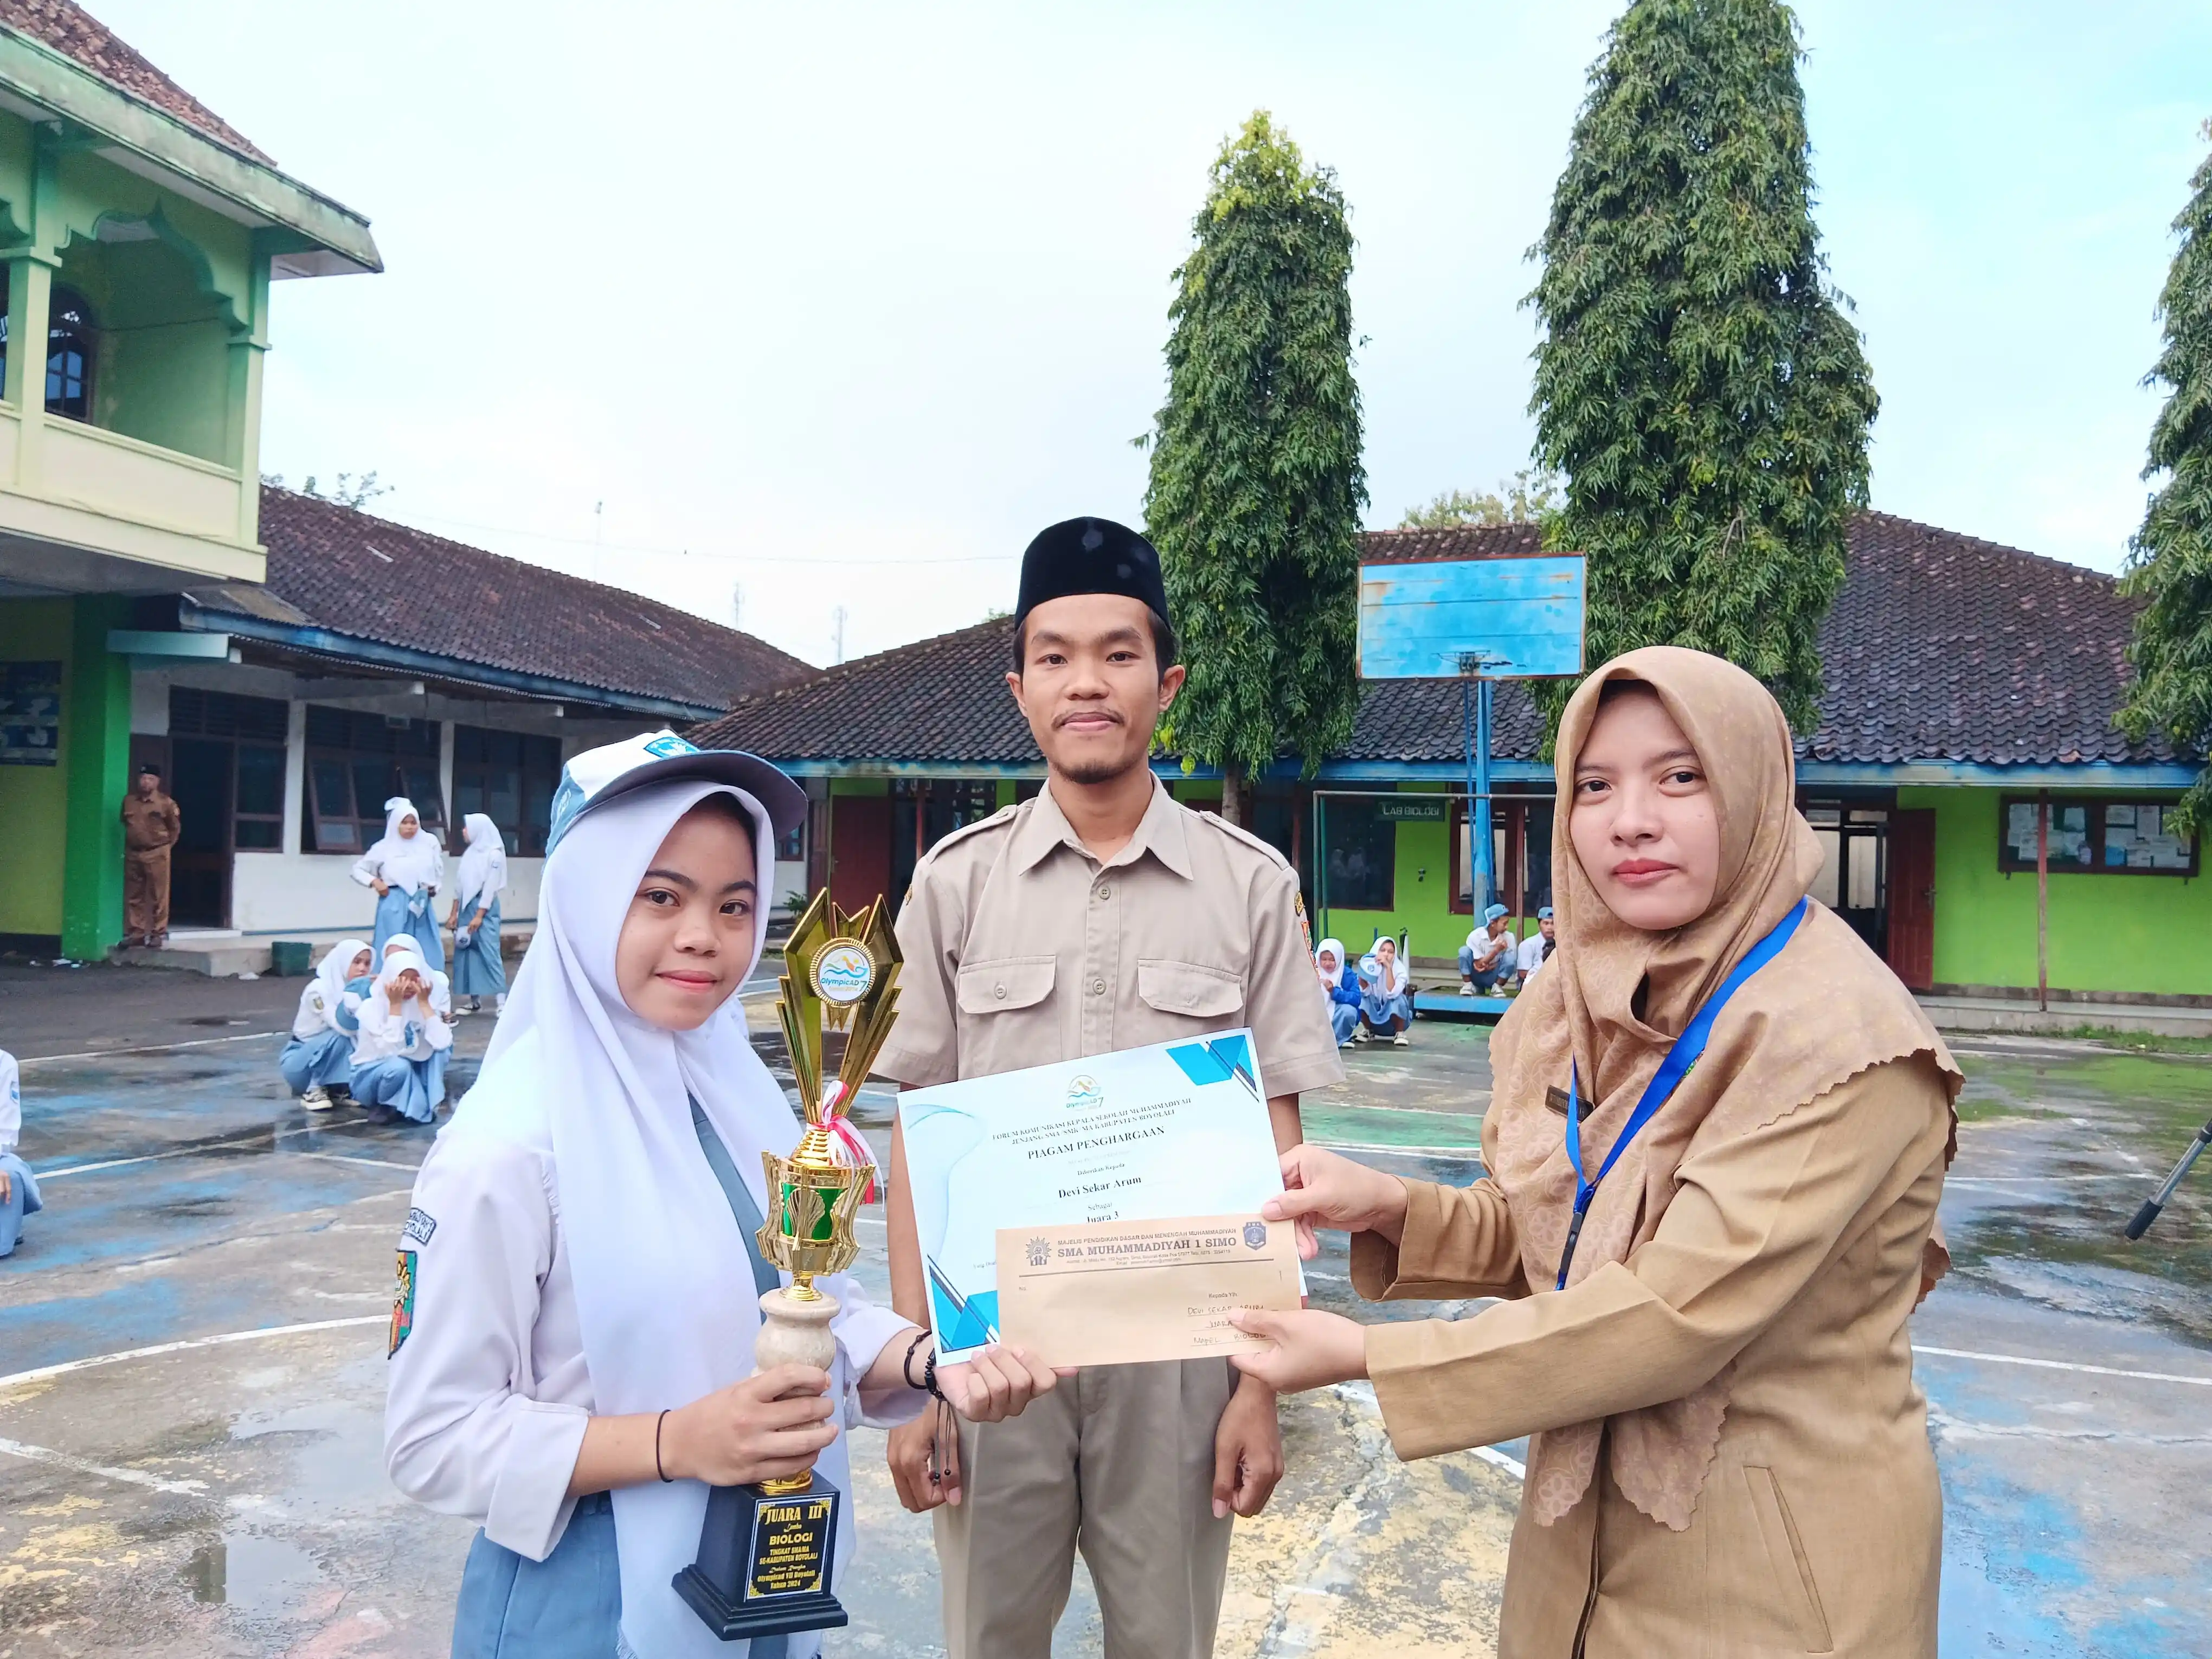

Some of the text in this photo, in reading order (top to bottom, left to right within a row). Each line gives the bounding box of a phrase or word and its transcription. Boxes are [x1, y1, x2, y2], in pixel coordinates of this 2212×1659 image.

[1383, 806, 1439, 816] LAB BIOLOGI
[859, 980, 867, 992] 7
[1098, 1097, 1104, 1108] 7
[993, 1097, 1191, 1140] FORUM KOMUNIKASI KEPALA SEKOLAH MUHAMMADIYAH
[1012, 1134, 1043, 1145] JENJANG
[1095, 1117, 1137, 1129] KABUPATEN
[1140, 1109, 1175, 1121] BOYOLALI
[1028, 1143, 1074, 1159] PIAGAM
[1077, 1126, 1165, 1149] PENGHARGAAN
[1077, 1162, 1126, 1176] Diberikan Kepada
[1058, 1176, 1141, 1198] Devi Sekar Arum
[1088, 1202, 1113, 1211] Sebagai
[1086, 1211, 1119, 1224] Juara 3
[1058, 1237, 1237, 1257] SMA MUHAMMADIYAH 1 SIMO
[1188, 1307, 1204, 1315] DEVI
[1205, 1320, 1233, 1328] JUARA
[764, 1505, 822, 1525] JUARA III
[769, 1532, 813, 1545] BIOLOGI
[770, 1547, 791, 1555] TINGKAT
[759, 1552, 818, 1565] SE-KABUPATEN BOYOLALI
[794, 1570, 815, 1578] Boyolali
